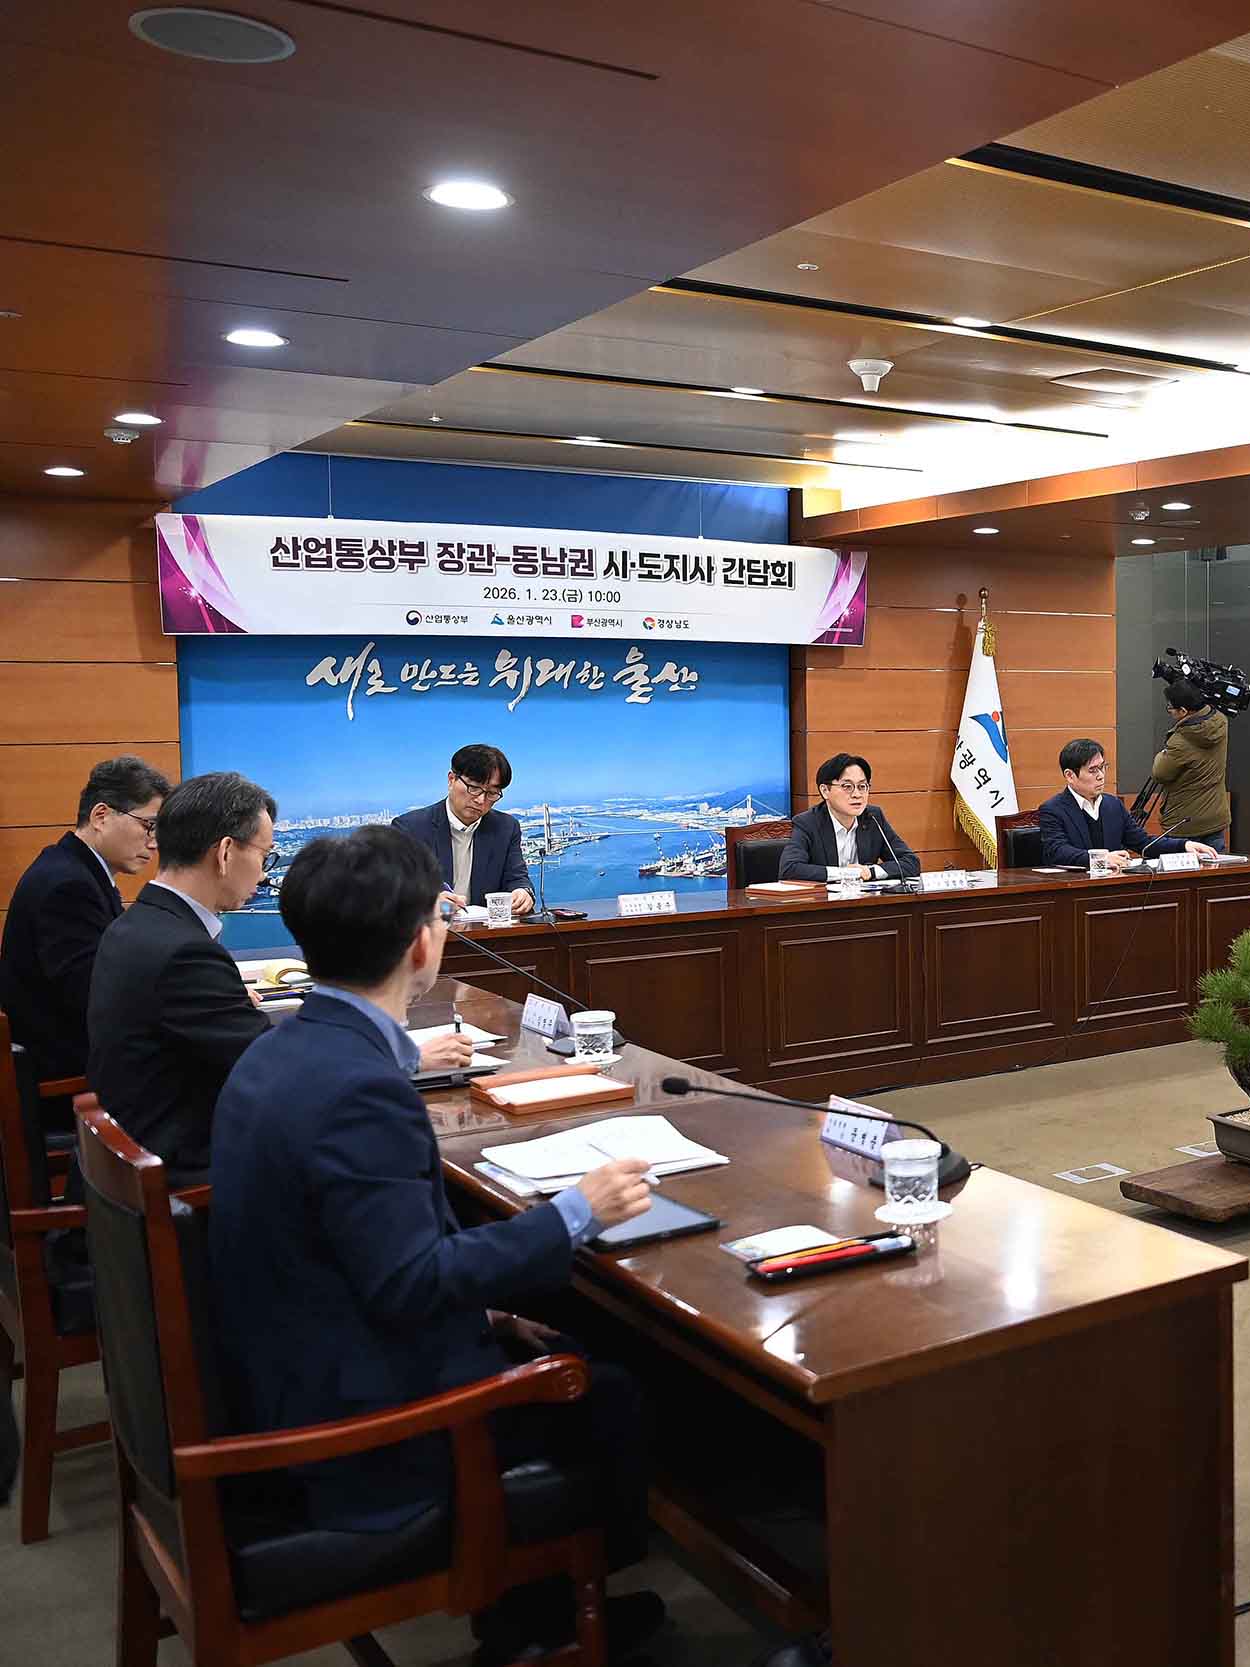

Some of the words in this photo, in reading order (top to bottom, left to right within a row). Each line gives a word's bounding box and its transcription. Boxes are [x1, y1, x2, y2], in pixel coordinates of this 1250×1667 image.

[270, 536, 427, 572] 산업통상부
[436, 542, 595, 578] 장관-동남권
[603, 550, 715, 583] 시·도지사
[722, 557, 794, 588] 간담회
[483, 586, 520, 601] 2026.
[526, 588, 537, 601] 1.
[588, 590, 621, 603] 10:00
[425, 614, 469, 624] 산업통상부
[506, 614, 552, 625] 울산광역시
[586, 618, 623, 628] 부산광역시
[657, 618, 690, 629] 경상남도
[305, 641, 399, 721] 새로
[400, 658, 481, 692] 만드는
[488, 649, 605, 712] 위대한
[613, 646, 698, 704] 울산
